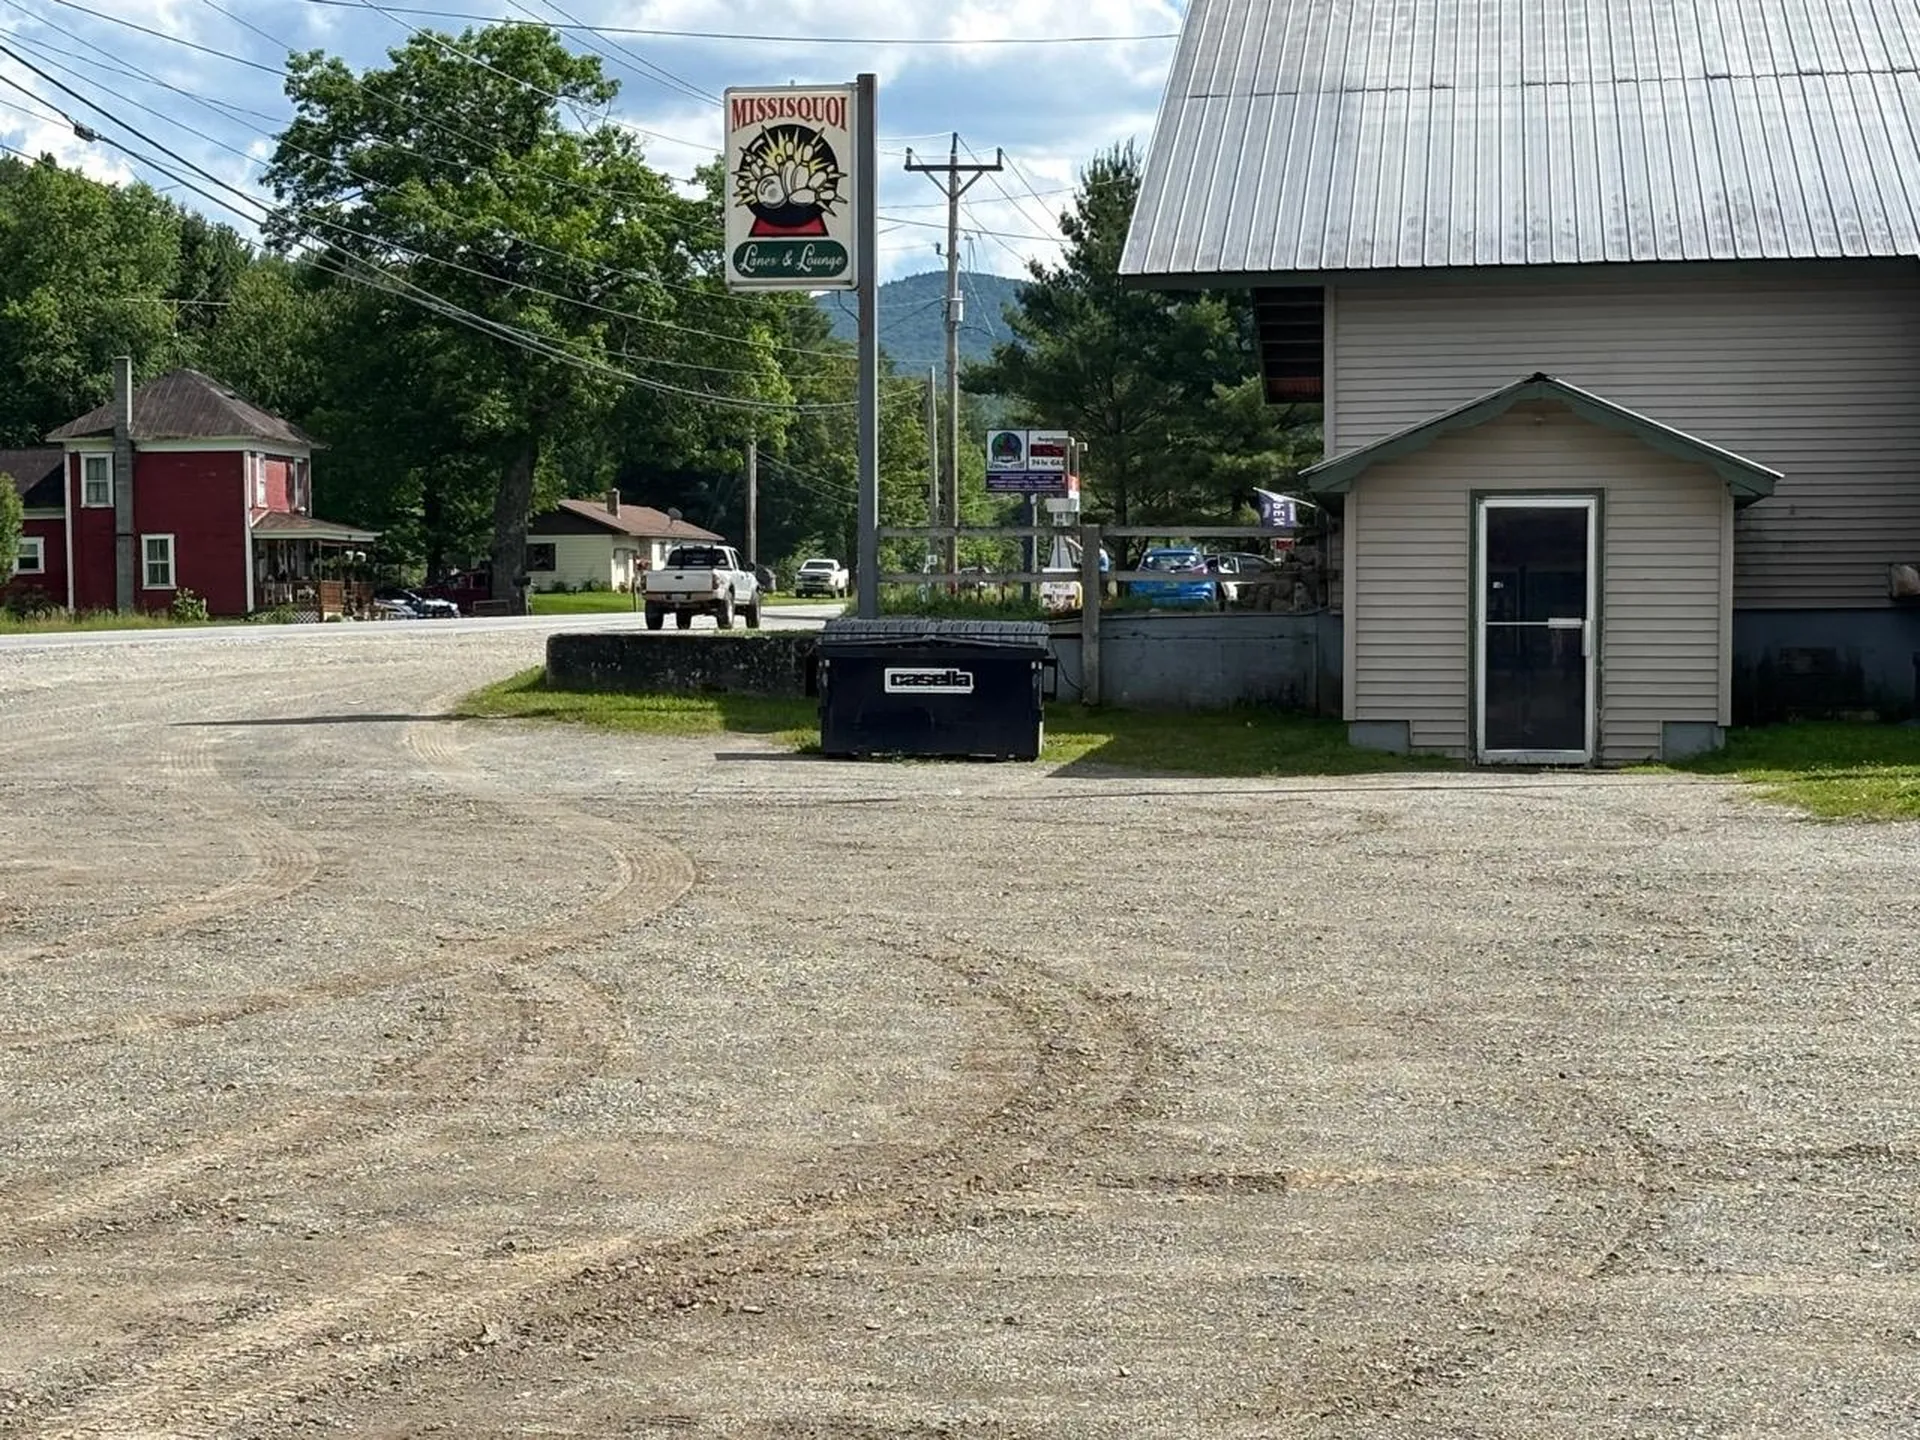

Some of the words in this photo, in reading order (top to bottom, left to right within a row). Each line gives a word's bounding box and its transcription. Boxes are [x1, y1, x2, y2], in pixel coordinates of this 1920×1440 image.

[731, 96, 848, 132] MISSISQUOI
[738, 243, 778, 272] Lanes
[782, 249, 794, 267] &
[795, 243, 844, 272] Lounge
[890, 670, 971, 687] casella
